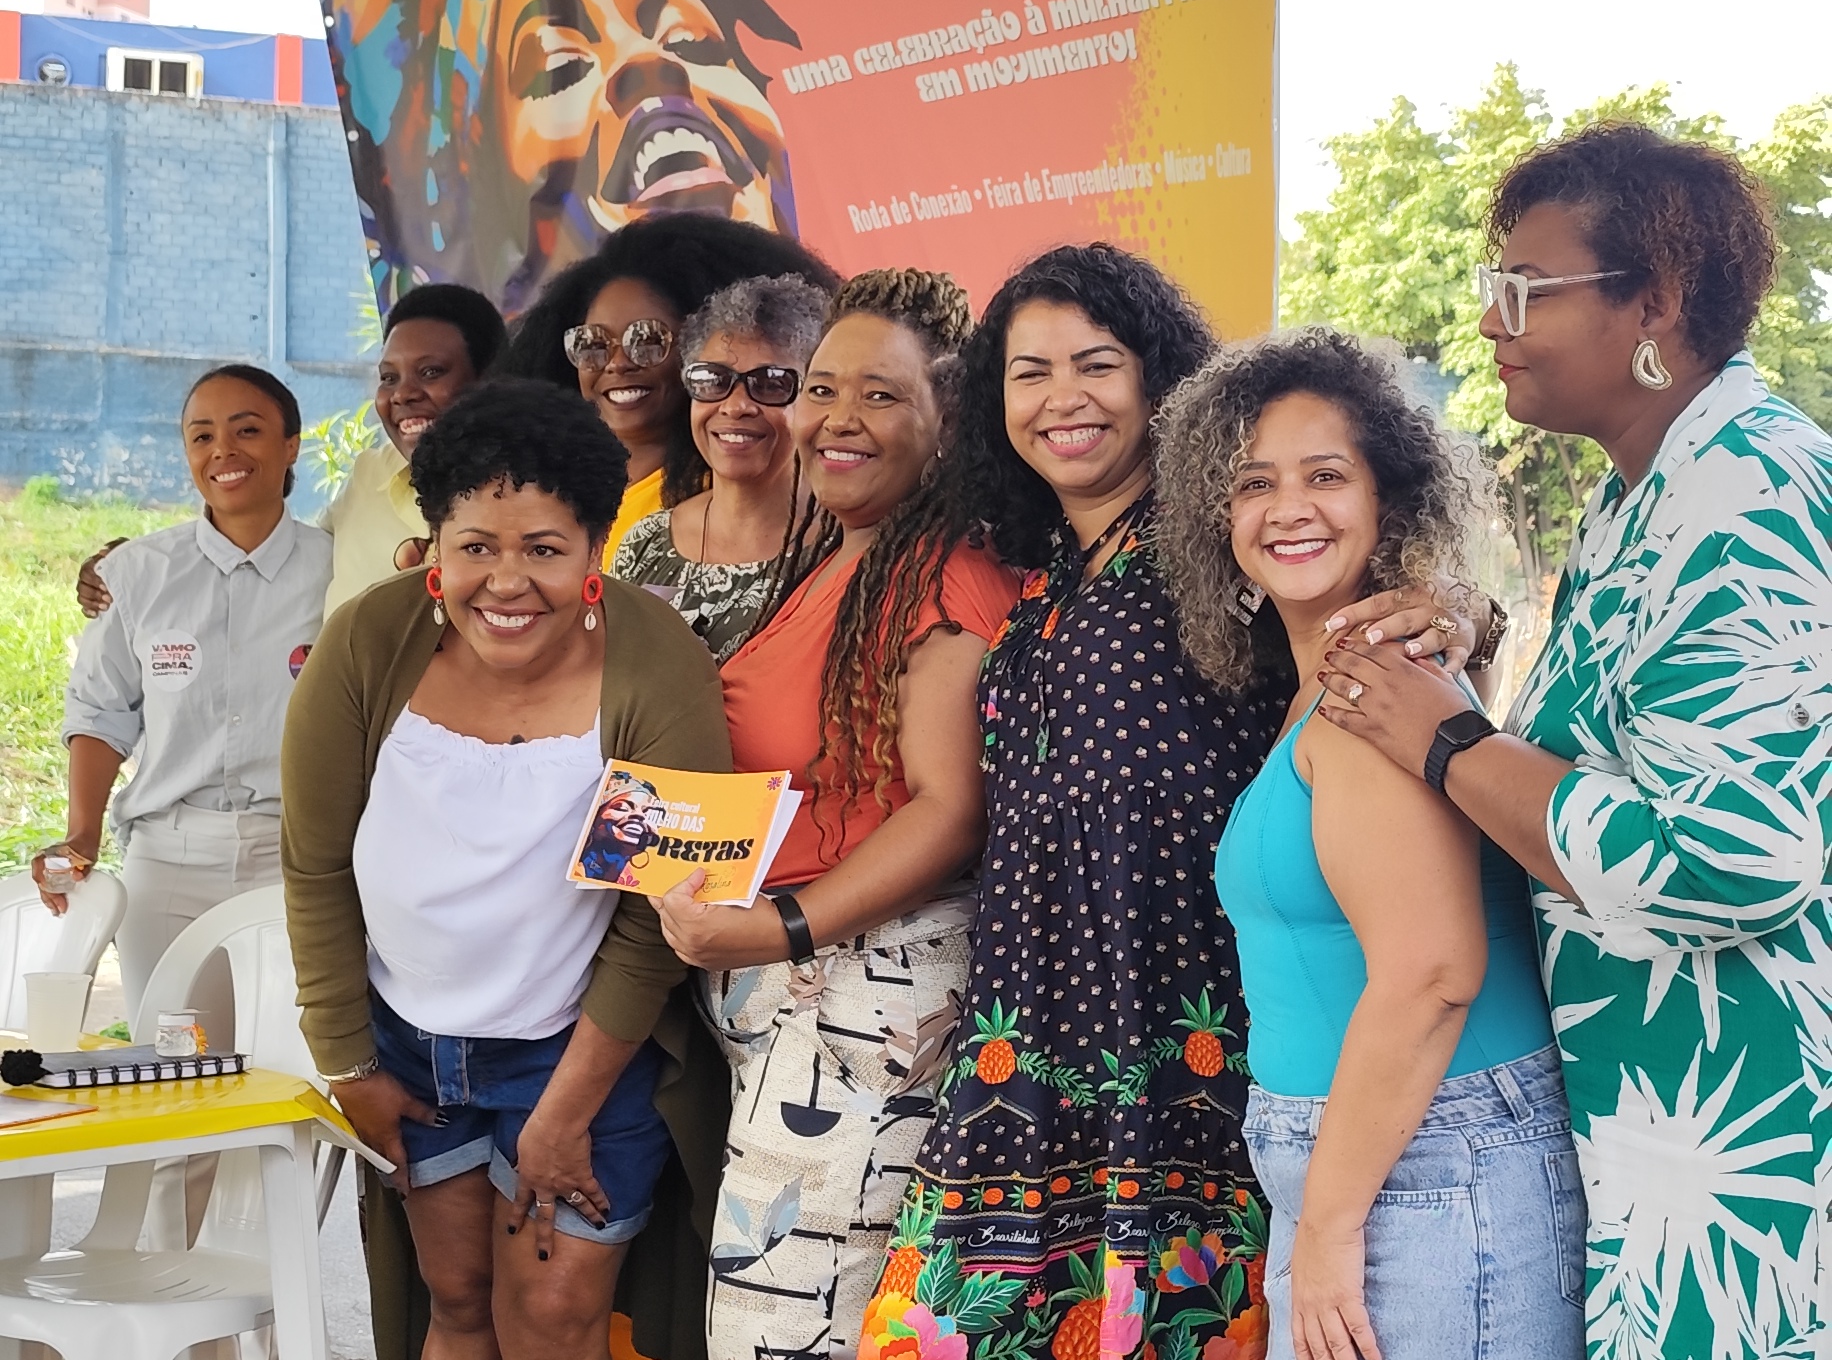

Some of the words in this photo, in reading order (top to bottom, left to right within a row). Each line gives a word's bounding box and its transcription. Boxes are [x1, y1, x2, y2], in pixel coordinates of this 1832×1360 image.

[782, 54, 853, 95] UMA
[853, 8, 1022, 76] CELEBRAÇÃO
[915, 68, 964, 103] EM
[963, 28, 1138, 93] MOVIMENTO!
[847, 200, 892, 234] Roda
[890, 195, 912, 226] de
[909, 184, 973, 222] Conexão
[982, 176, 1024, 209] Feira
[1023, 171, 1043, 203] de
[1041, 156, 1153, 206] Empreendedoras
[1163, 147, 1206, 185] Música
[1215, 141, 1251, 179] Cultura
[670, 800, 701, 814] cultural
[680, 815, 706, 833] DAS
